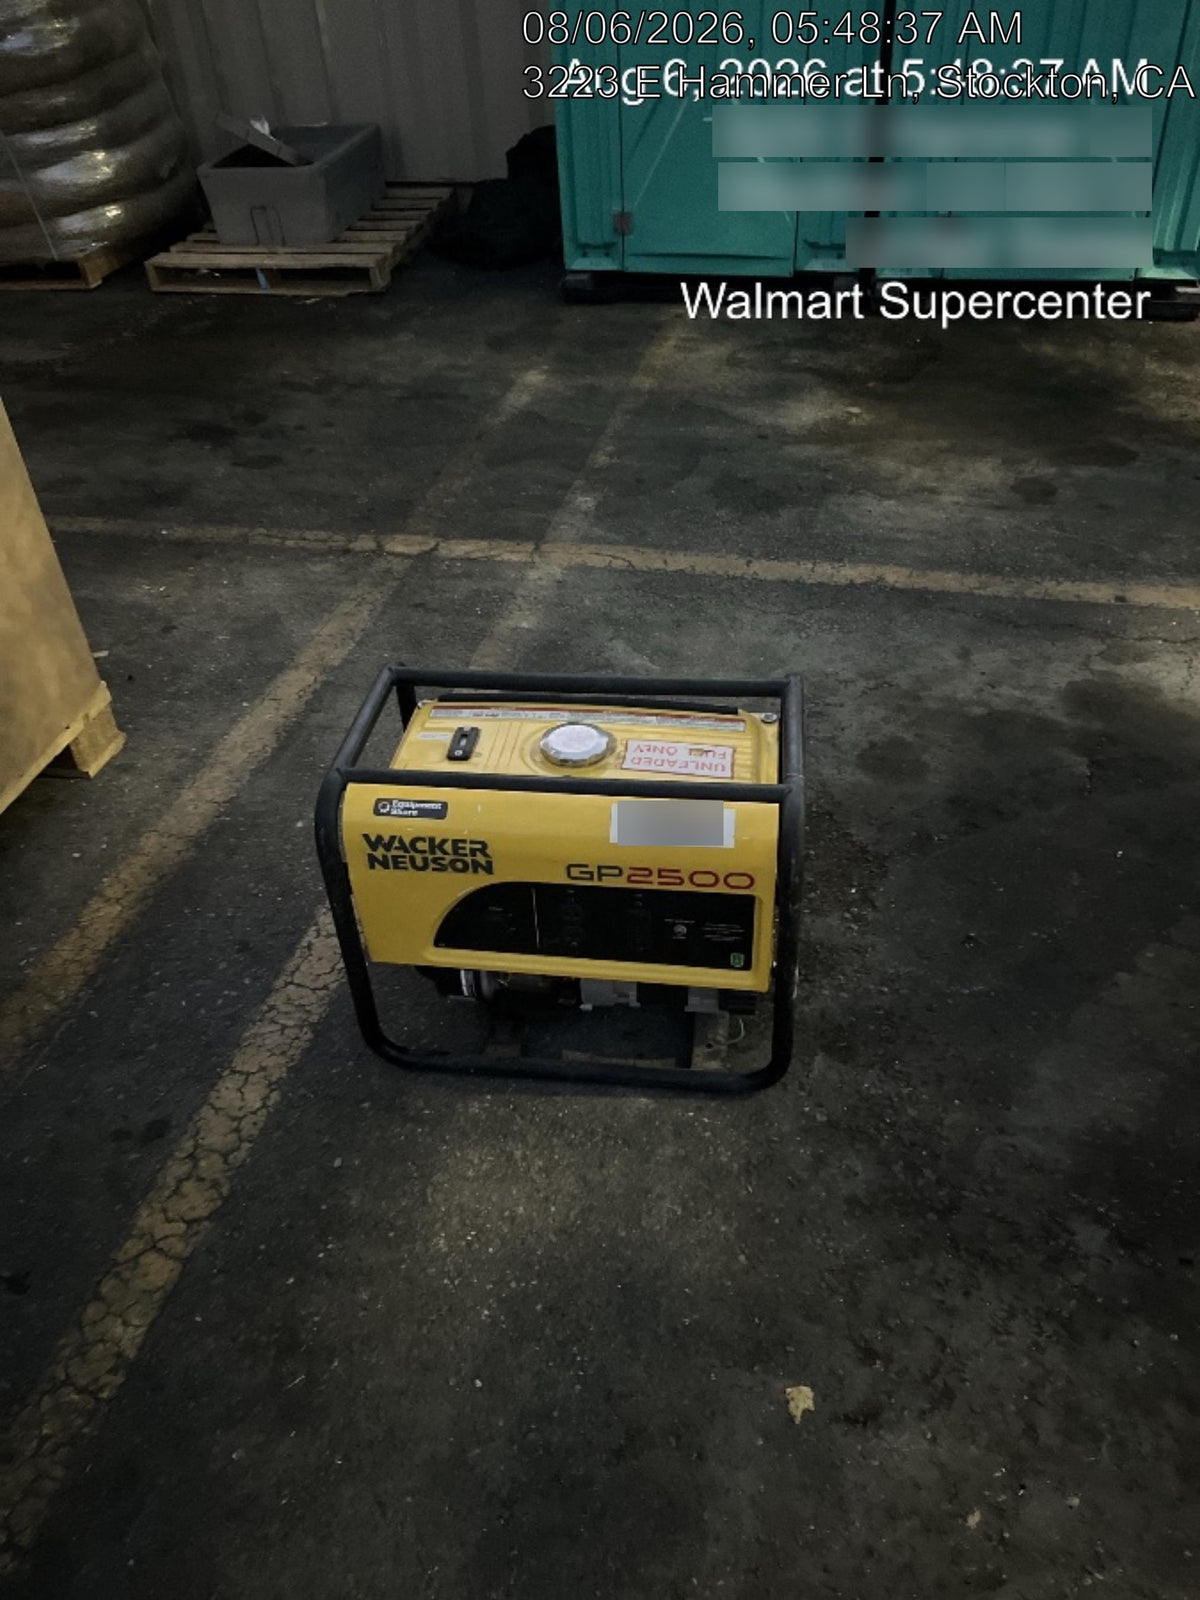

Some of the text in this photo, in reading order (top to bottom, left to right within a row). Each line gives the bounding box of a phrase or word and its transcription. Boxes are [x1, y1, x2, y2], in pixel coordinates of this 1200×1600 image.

[631, 756, 726, 773] UNLEADED
[361, 833, 492, 859] WACKER
[366, 852, 494, 875] NEUSON
[566, 863, 755, 890] GP2500
